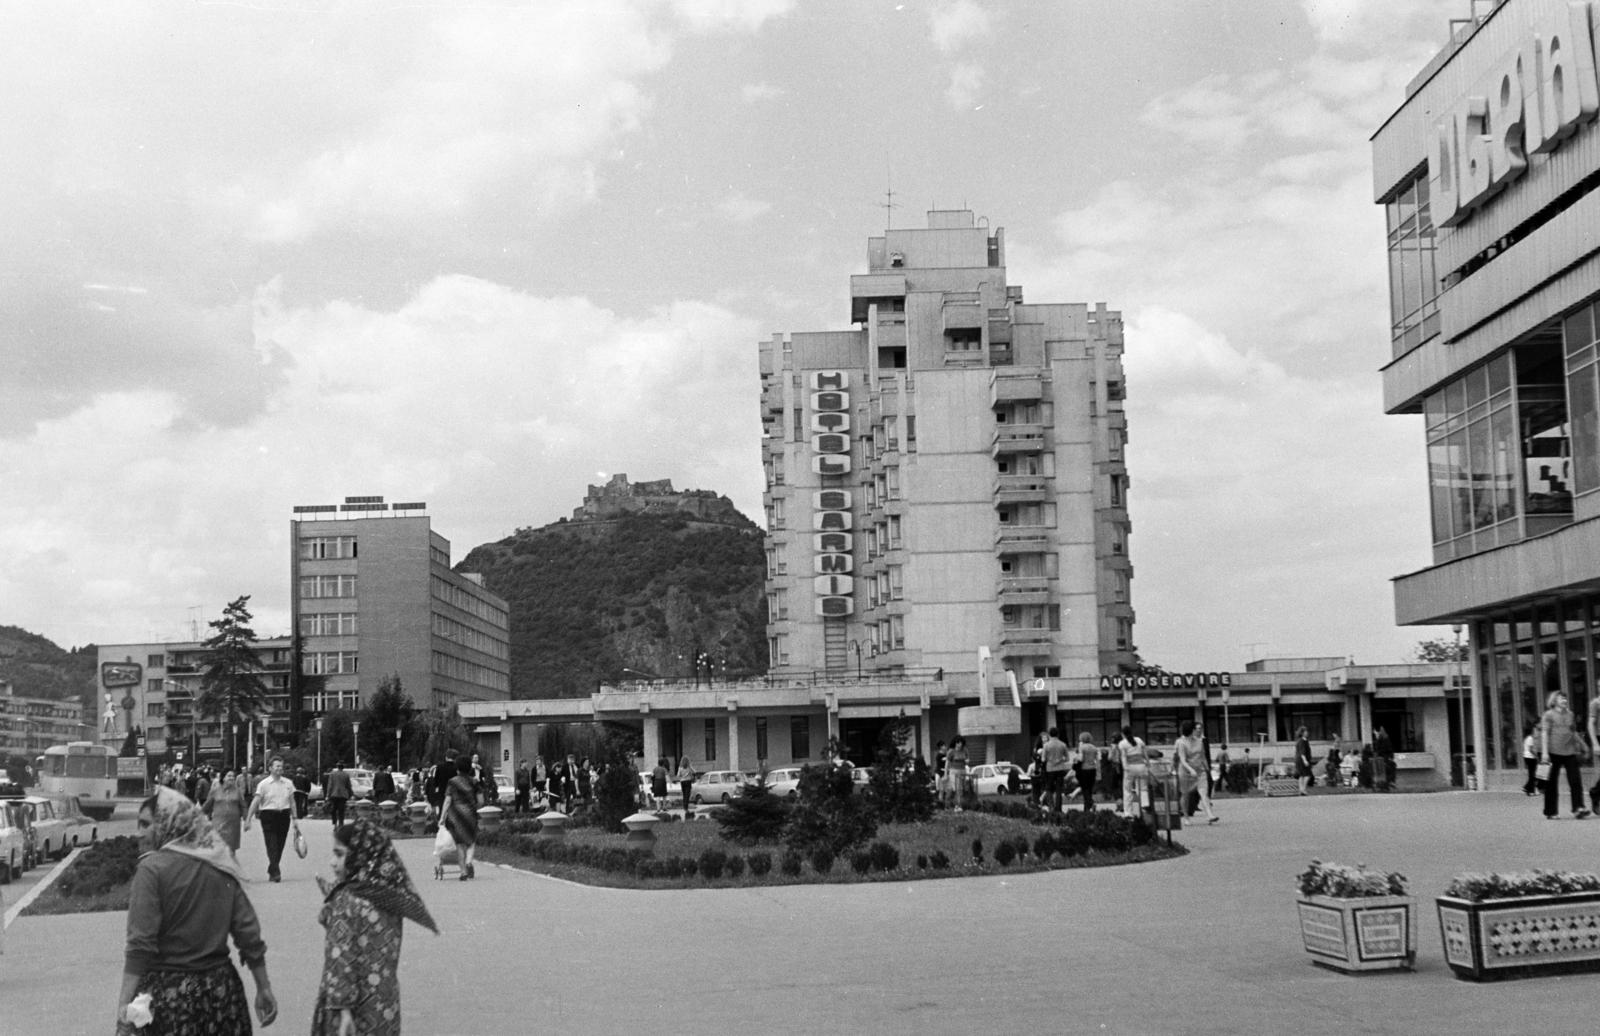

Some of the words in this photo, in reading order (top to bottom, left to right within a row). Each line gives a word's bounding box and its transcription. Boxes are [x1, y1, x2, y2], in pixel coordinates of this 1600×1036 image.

[815, 371, 847, 473] HOTEL
[818, 491, 850, 614] SARMIS
[1101, 673, 1229, 689] AUTOSERVIRE
